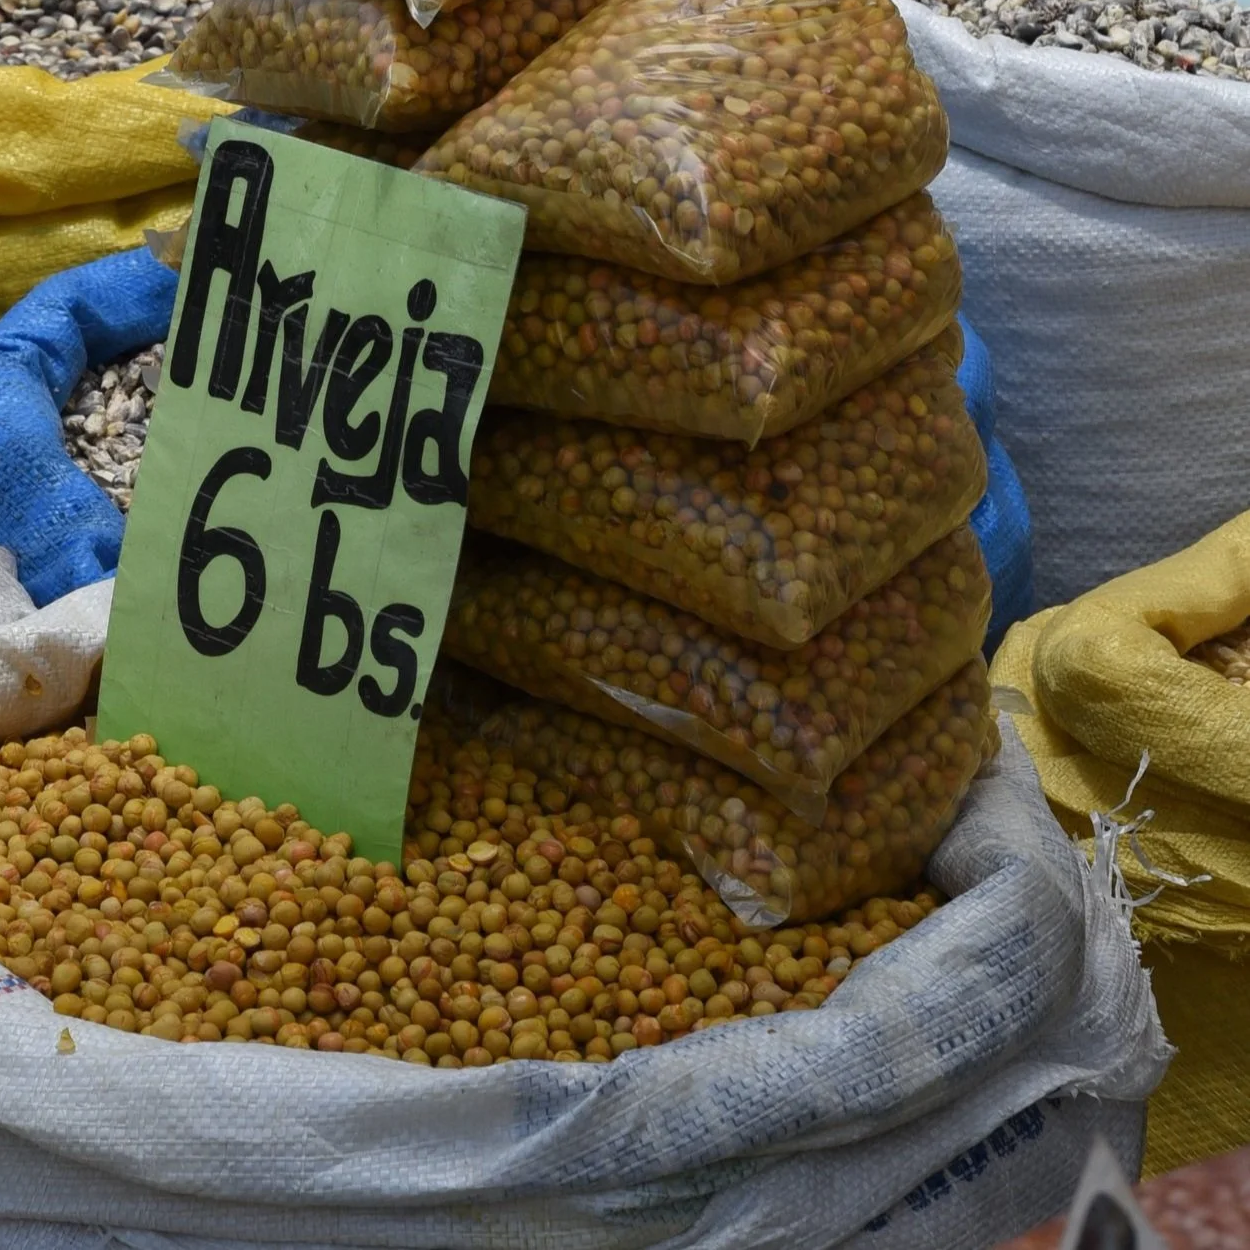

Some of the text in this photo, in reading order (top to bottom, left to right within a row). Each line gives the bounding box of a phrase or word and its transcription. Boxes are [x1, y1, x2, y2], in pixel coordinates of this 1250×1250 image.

[169, 139, 485, 510] Arveja
[177, 446, 423, 721] 6 bs.
